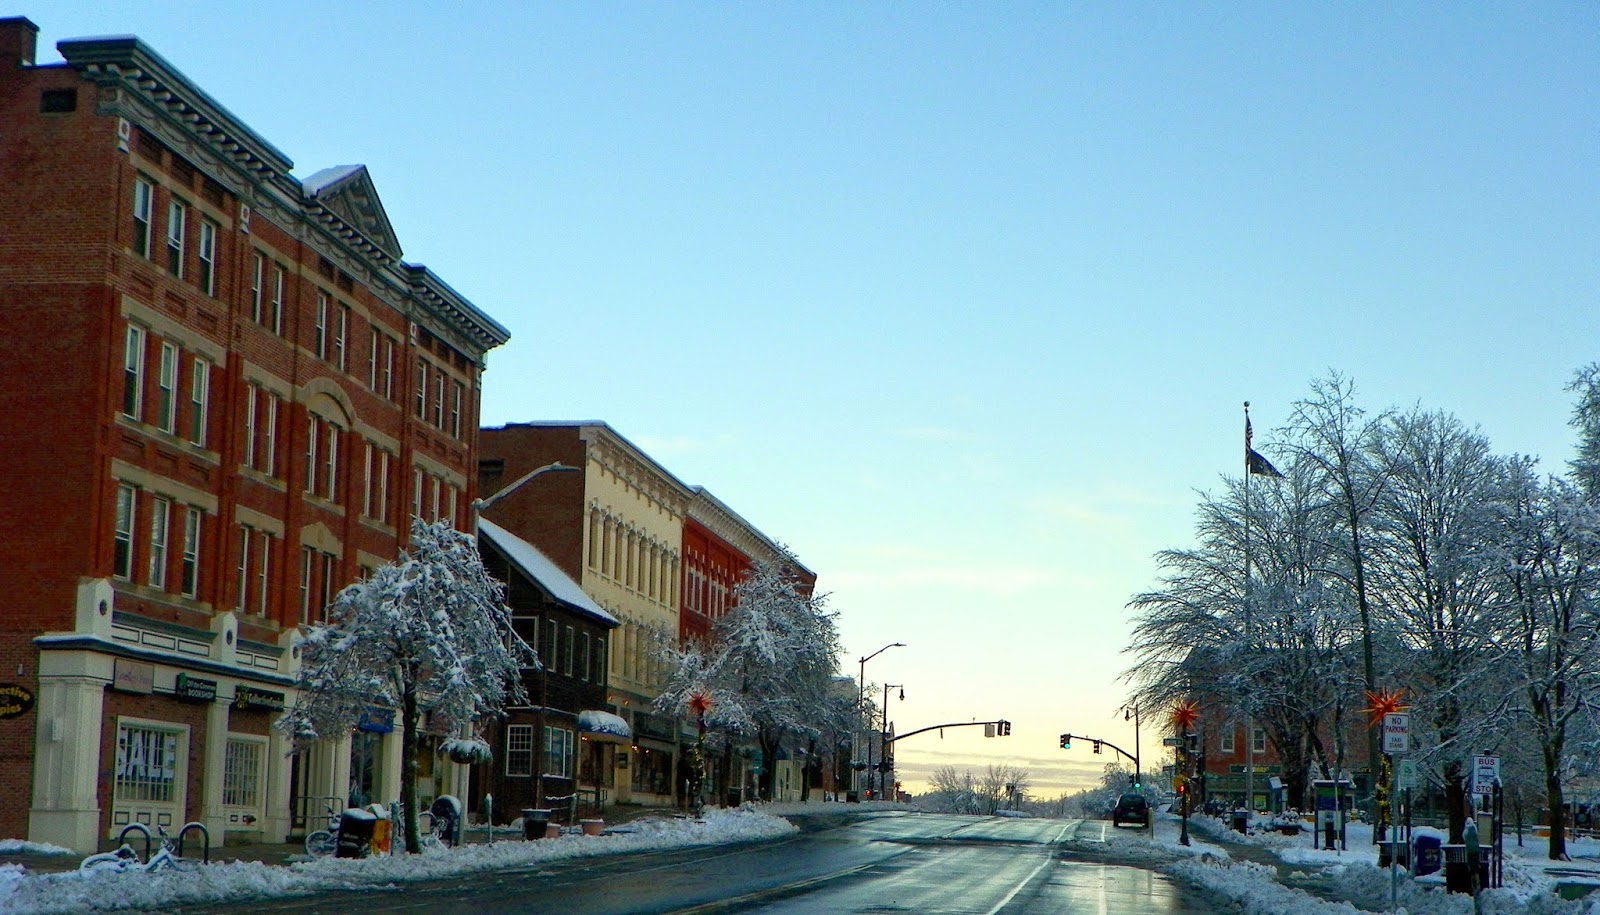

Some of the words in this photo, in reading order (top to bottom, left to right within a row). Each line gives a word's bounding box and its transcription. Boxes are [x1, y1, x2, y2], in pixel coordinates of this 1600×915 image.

[187, 688, 214, 699] BOOKSHOP
[1391, 717, 1402, 725] NO
[118, 728, 175, 779] SALE
